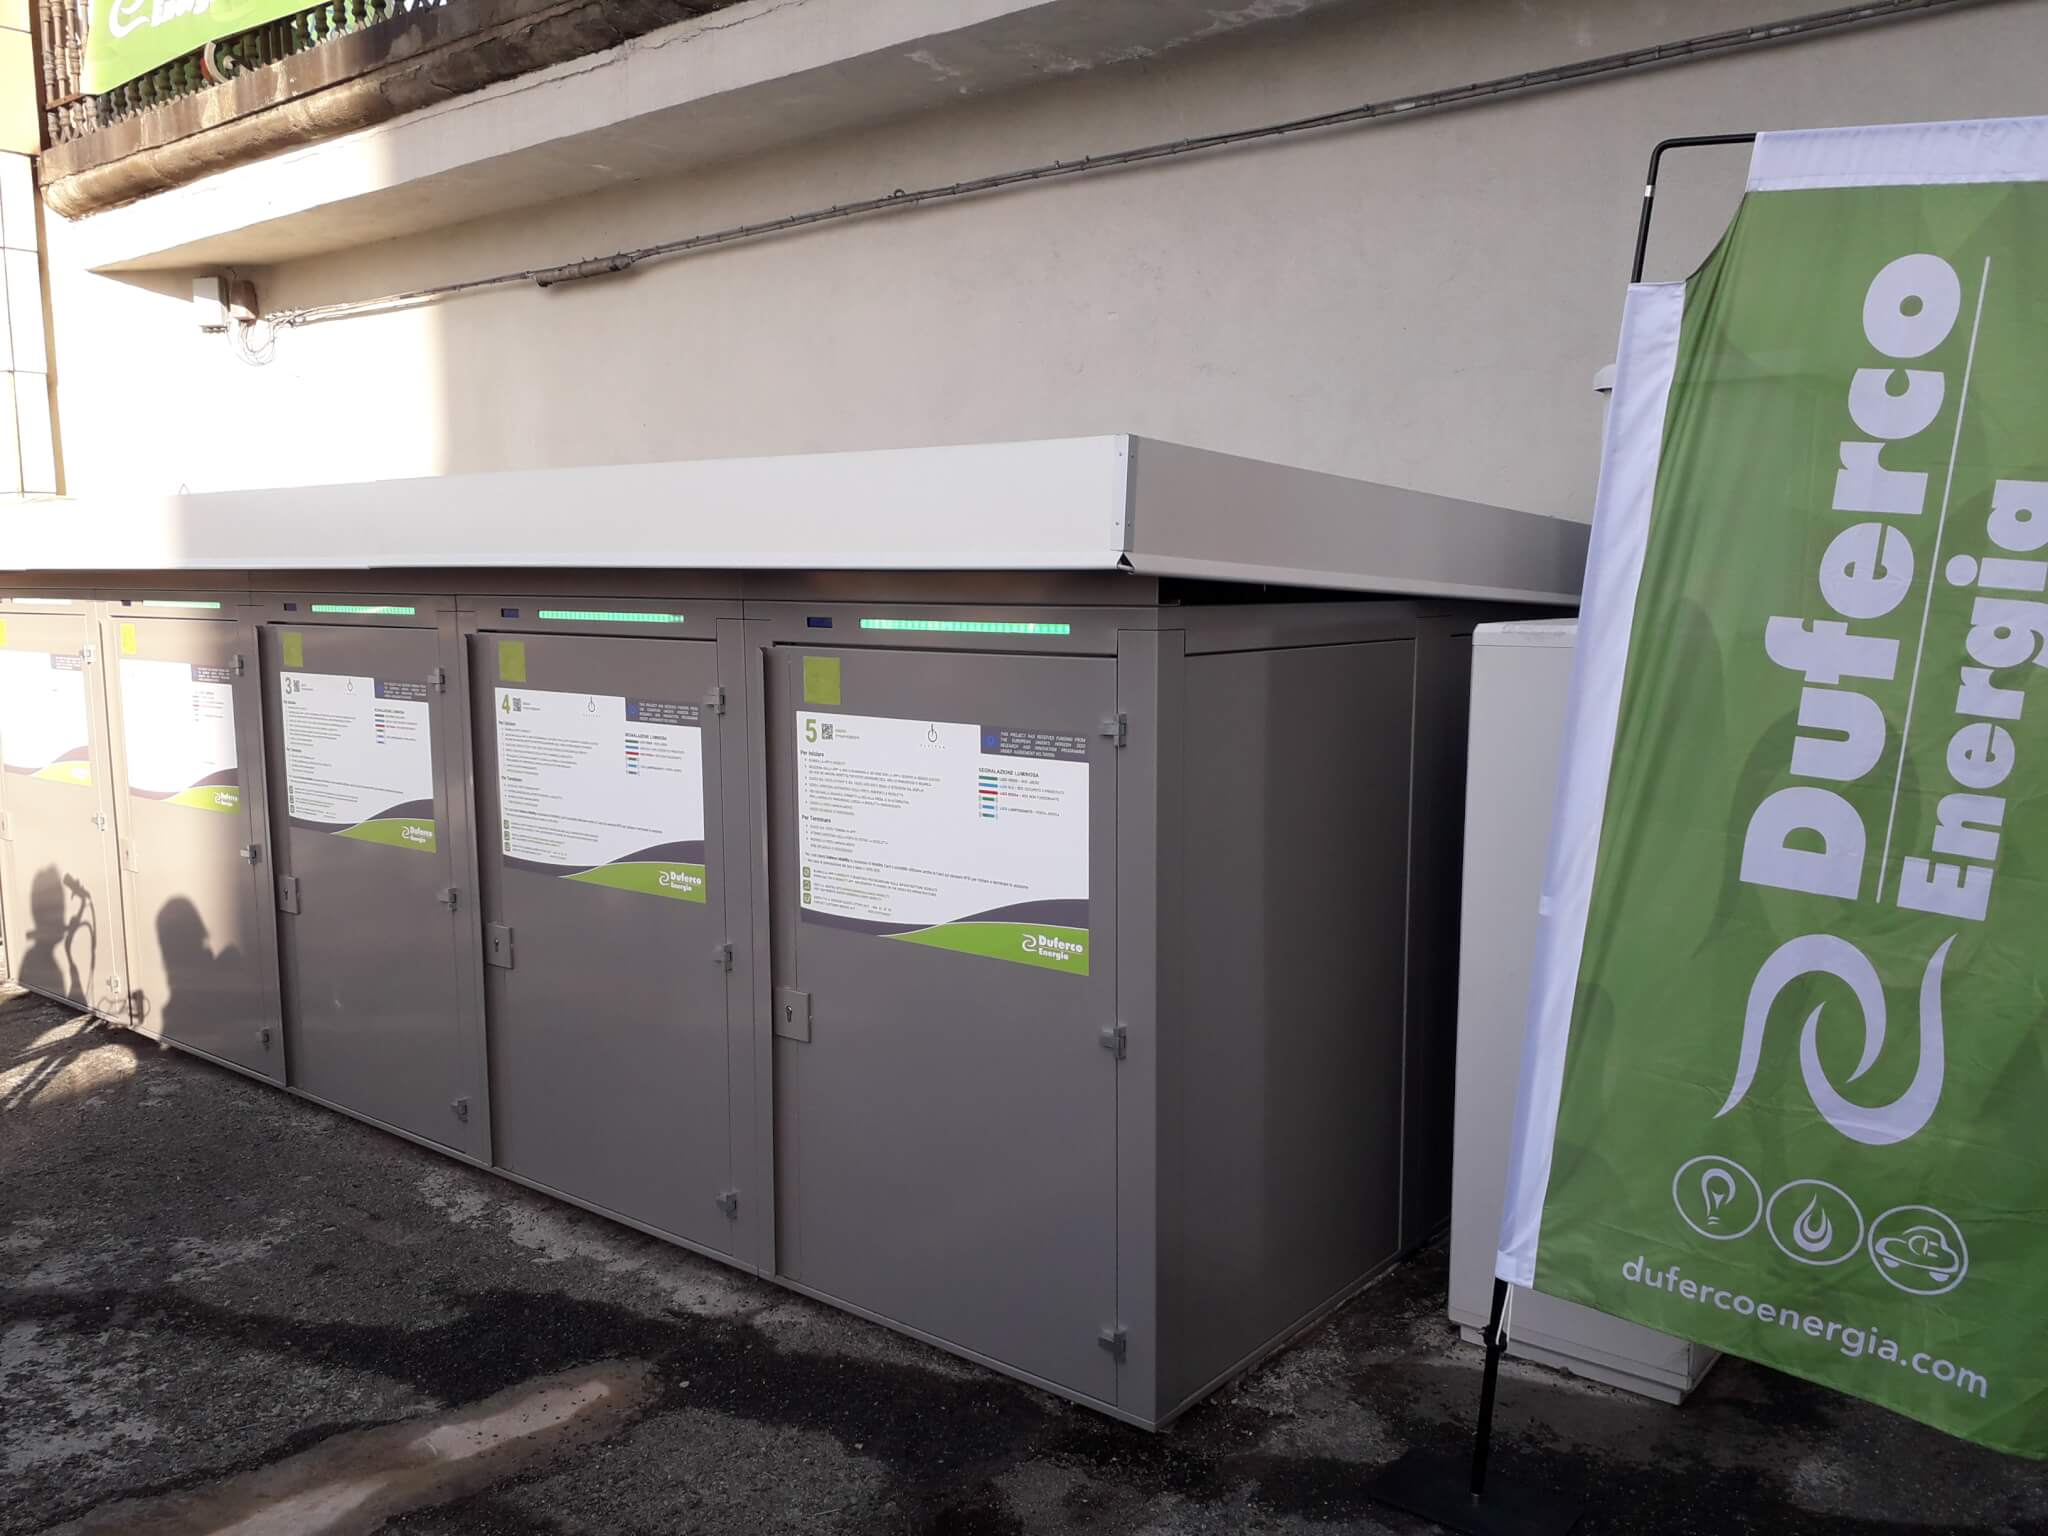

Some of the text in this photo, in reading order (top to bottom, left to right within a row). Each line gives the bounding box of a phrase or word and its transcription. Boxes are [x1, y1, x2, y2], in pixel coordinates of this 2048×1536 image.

[1739, 254, 1961, 900] Duferco
[285, 677, 293, 696] 3
[502, 694, 512, 714] 4
[1897, 479, 2048, 921] Energia
[806, 718, 817, 744] 5
[670, 871, 701, 884] Duferco
[1038, 934, 1083, 953] Duferco
[1038, 946, 1069, 961] Energia
[1621, 1256, 1988, 1399] dufercoenergia.com
